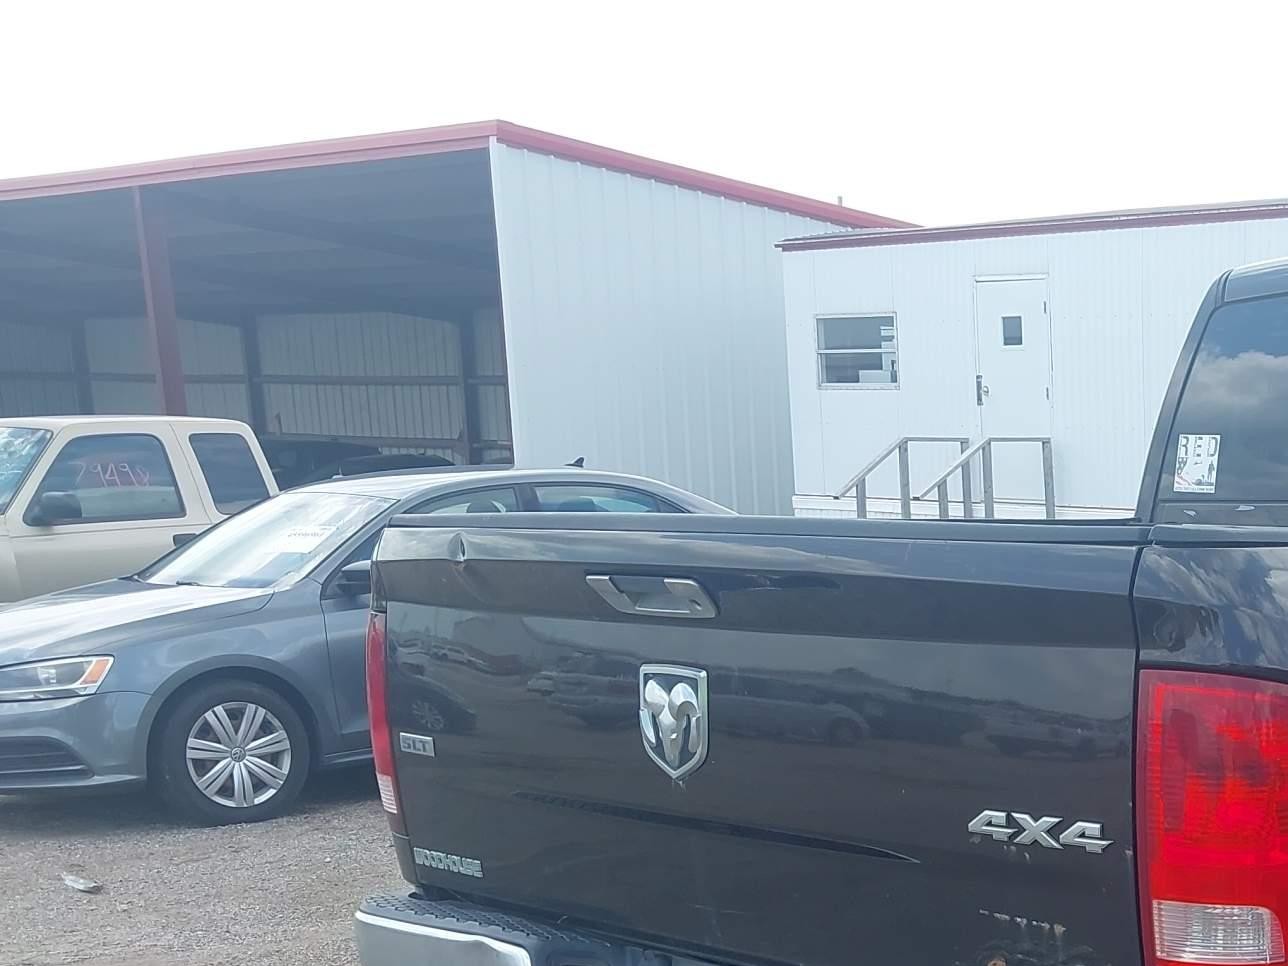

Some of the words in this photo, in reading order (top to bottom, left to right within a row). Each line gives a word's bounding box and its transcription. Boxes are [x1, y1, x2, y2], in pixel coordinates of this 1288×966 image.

[1179, 436, 1219, 457] RED
[401, 736, 431, 754] SLT
[968, 810, 1114, 854] 4X4
